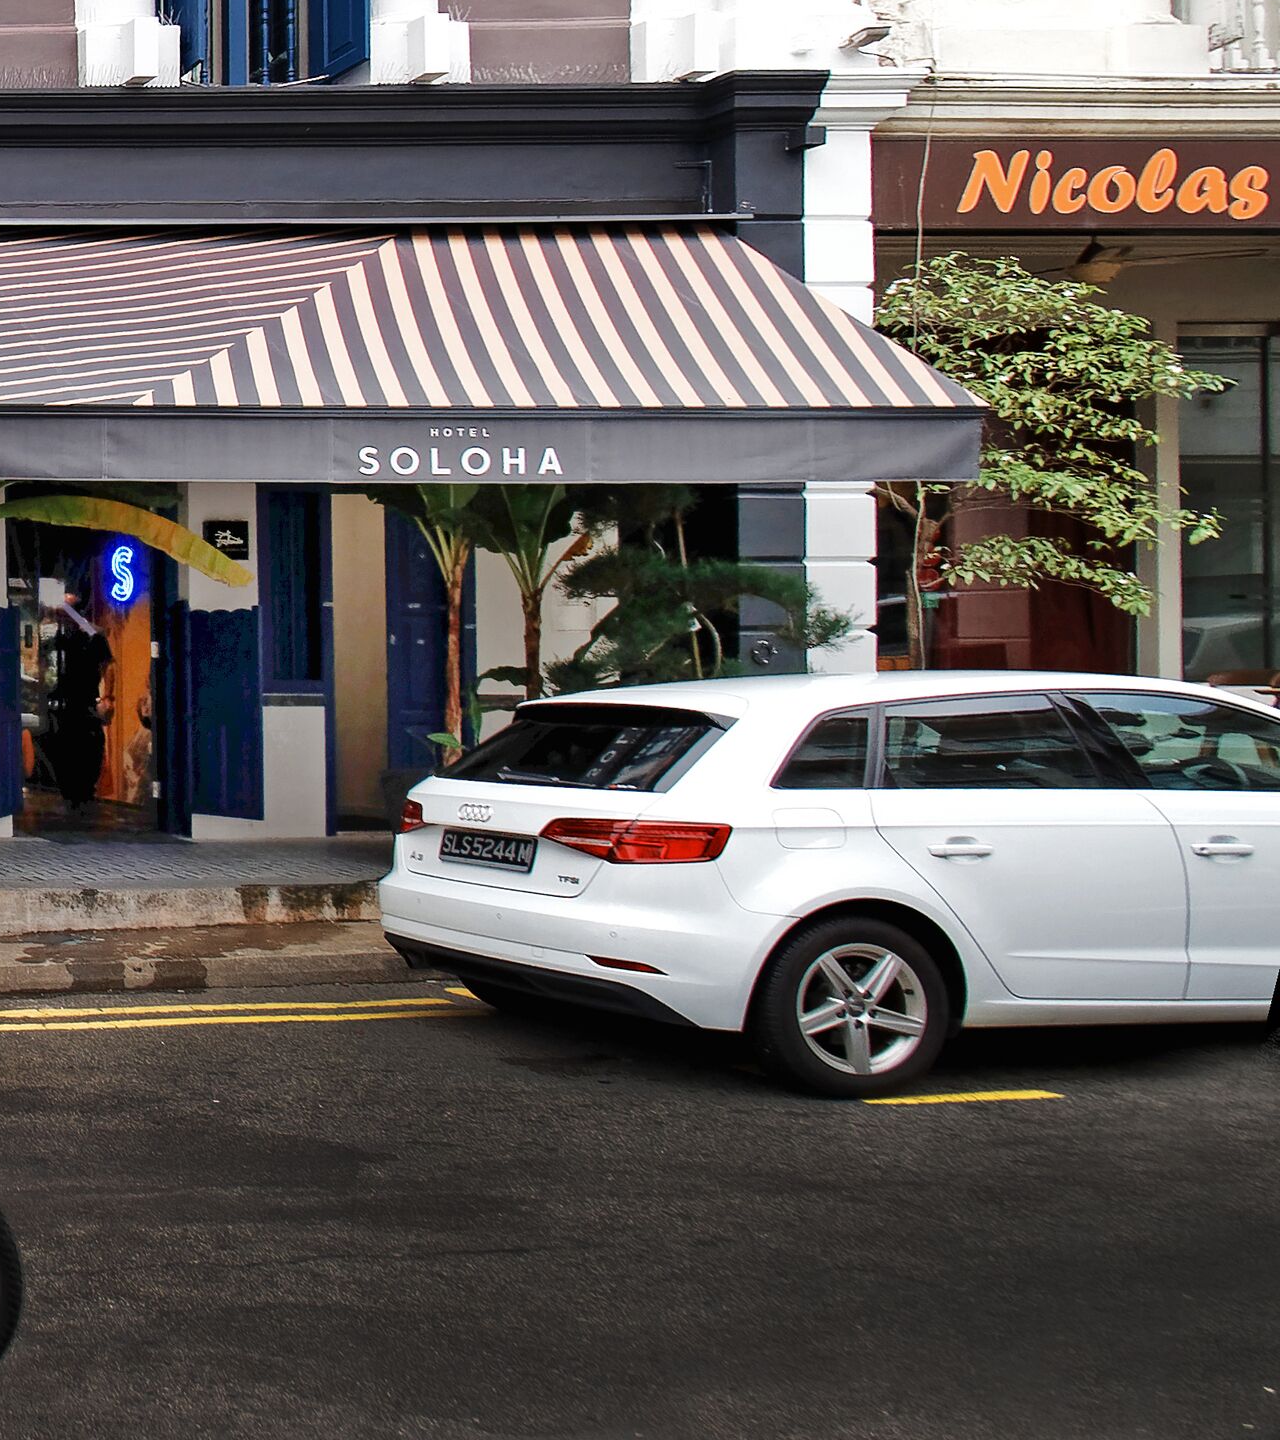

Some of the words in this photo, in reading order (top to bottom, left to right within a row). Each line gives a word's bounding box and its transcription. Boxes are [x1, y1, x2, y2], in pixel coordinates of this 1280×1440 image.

[956, 148, 1270, 221] Nicolas
[430, 427, 490, 438] HOTEL
[357, 445, 564, 476] SOLOHA
[111, 545, 134, 602] S
[442, 834, 532, 864] SLS5244M
